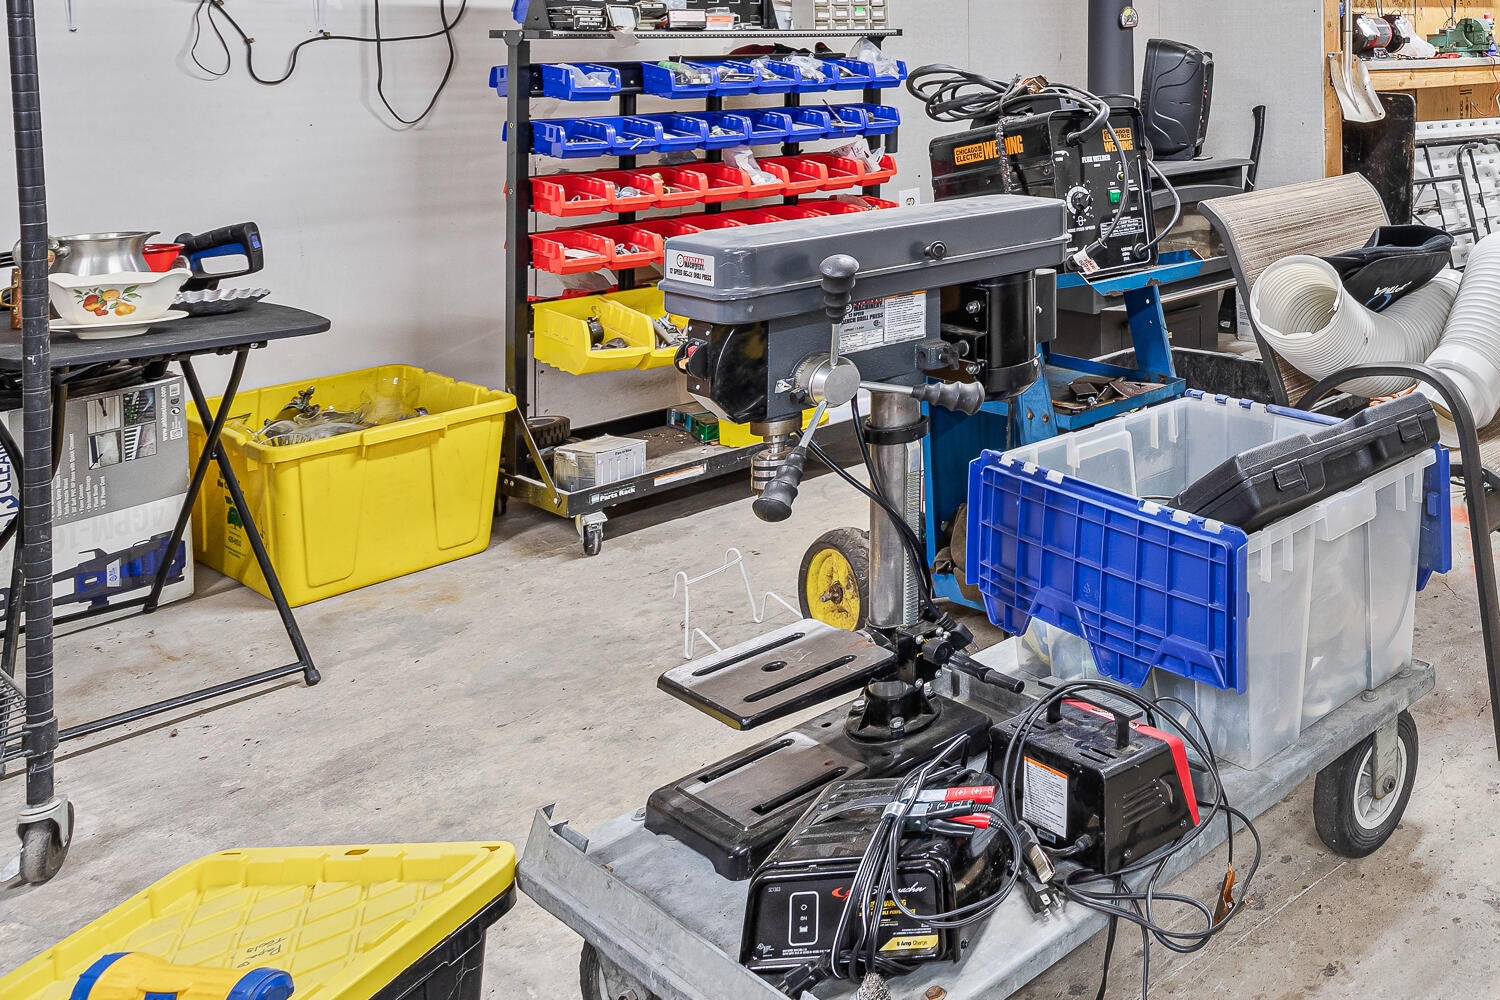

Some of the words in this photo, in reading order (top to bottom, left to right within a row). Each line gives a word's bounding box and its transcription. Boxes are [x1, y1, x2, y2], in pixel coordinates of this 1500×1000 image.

[955, 145, 978, 157] CHICAGO
[983, 135, 1023, 160] WEING
[955, 151, 984, 165] ELECTRIC
[600, 491, 618, 502] Parts
[618, 487, 636, 497] Rack
[901, 940, 912, 948] Amp
[912, 939, 928, 947] Charge
